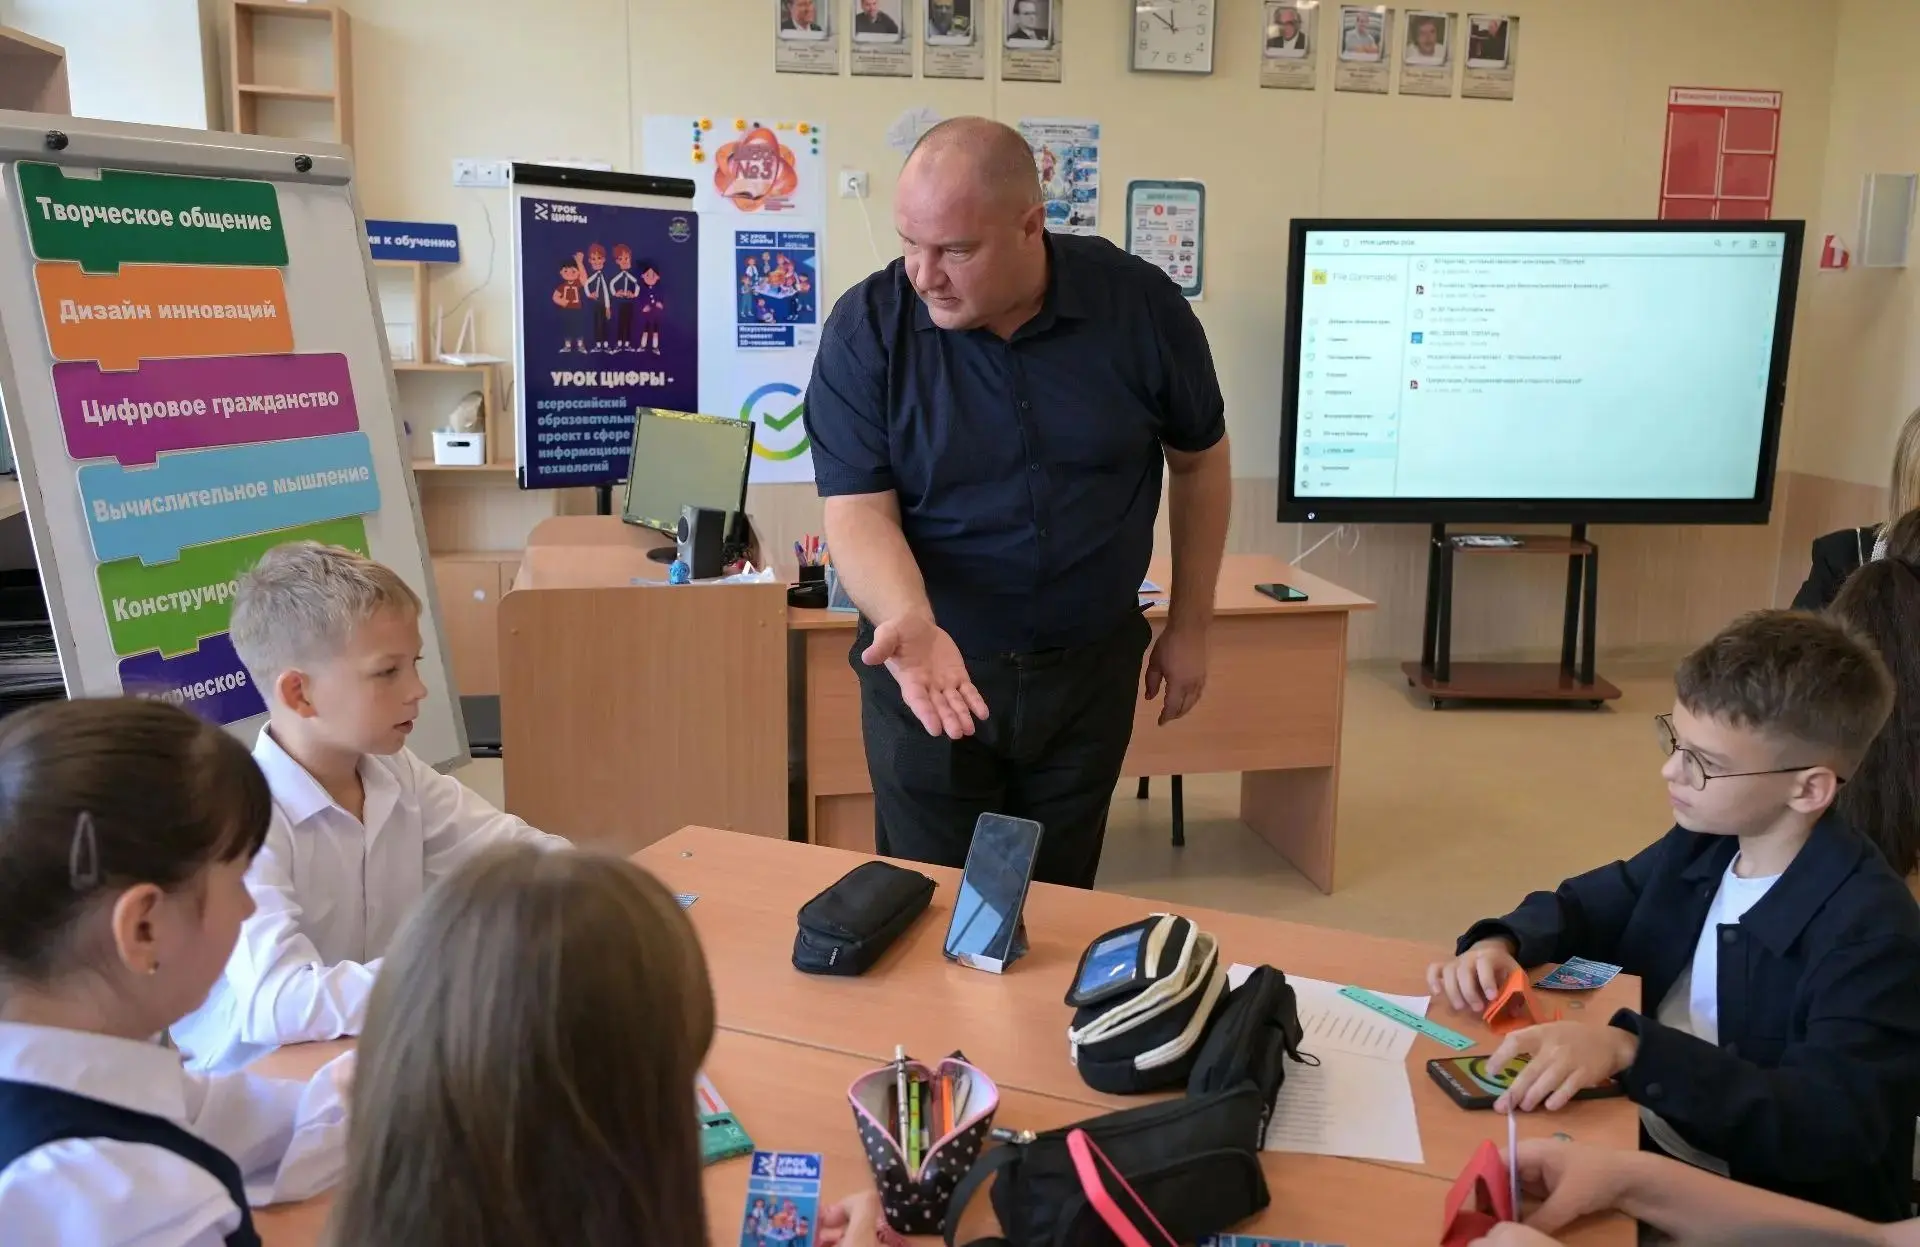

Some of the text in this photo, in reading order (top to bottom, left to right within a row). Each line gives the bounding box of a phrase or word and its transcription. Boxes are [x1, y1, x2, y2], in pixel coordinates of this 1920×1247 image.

[36, 196, 272, 232] Творческое общение
[551, 204, 577, 215] УРОК
[551, 213, 588, 224] ЦИФРЫ
[384, 236, 392, 245] к
[394, 235, 457, 249] обучению
[60, 299, 277, 324] Дизайн инноваций
[551, 371, 598, 387] УРОК
[600, 371, 665, 388] ЦИФРЫ
[82, 389, 339, 425] Цифровое гражданство
[537, 397, 627, 411] всероссийский
[538, 428, 630, 444] проект в сфере
[538, 460, 609, 475] технологий
[92, 465, 370, 523] Вычислительное мышление
[112, 579, 245, 622] Конструиро
